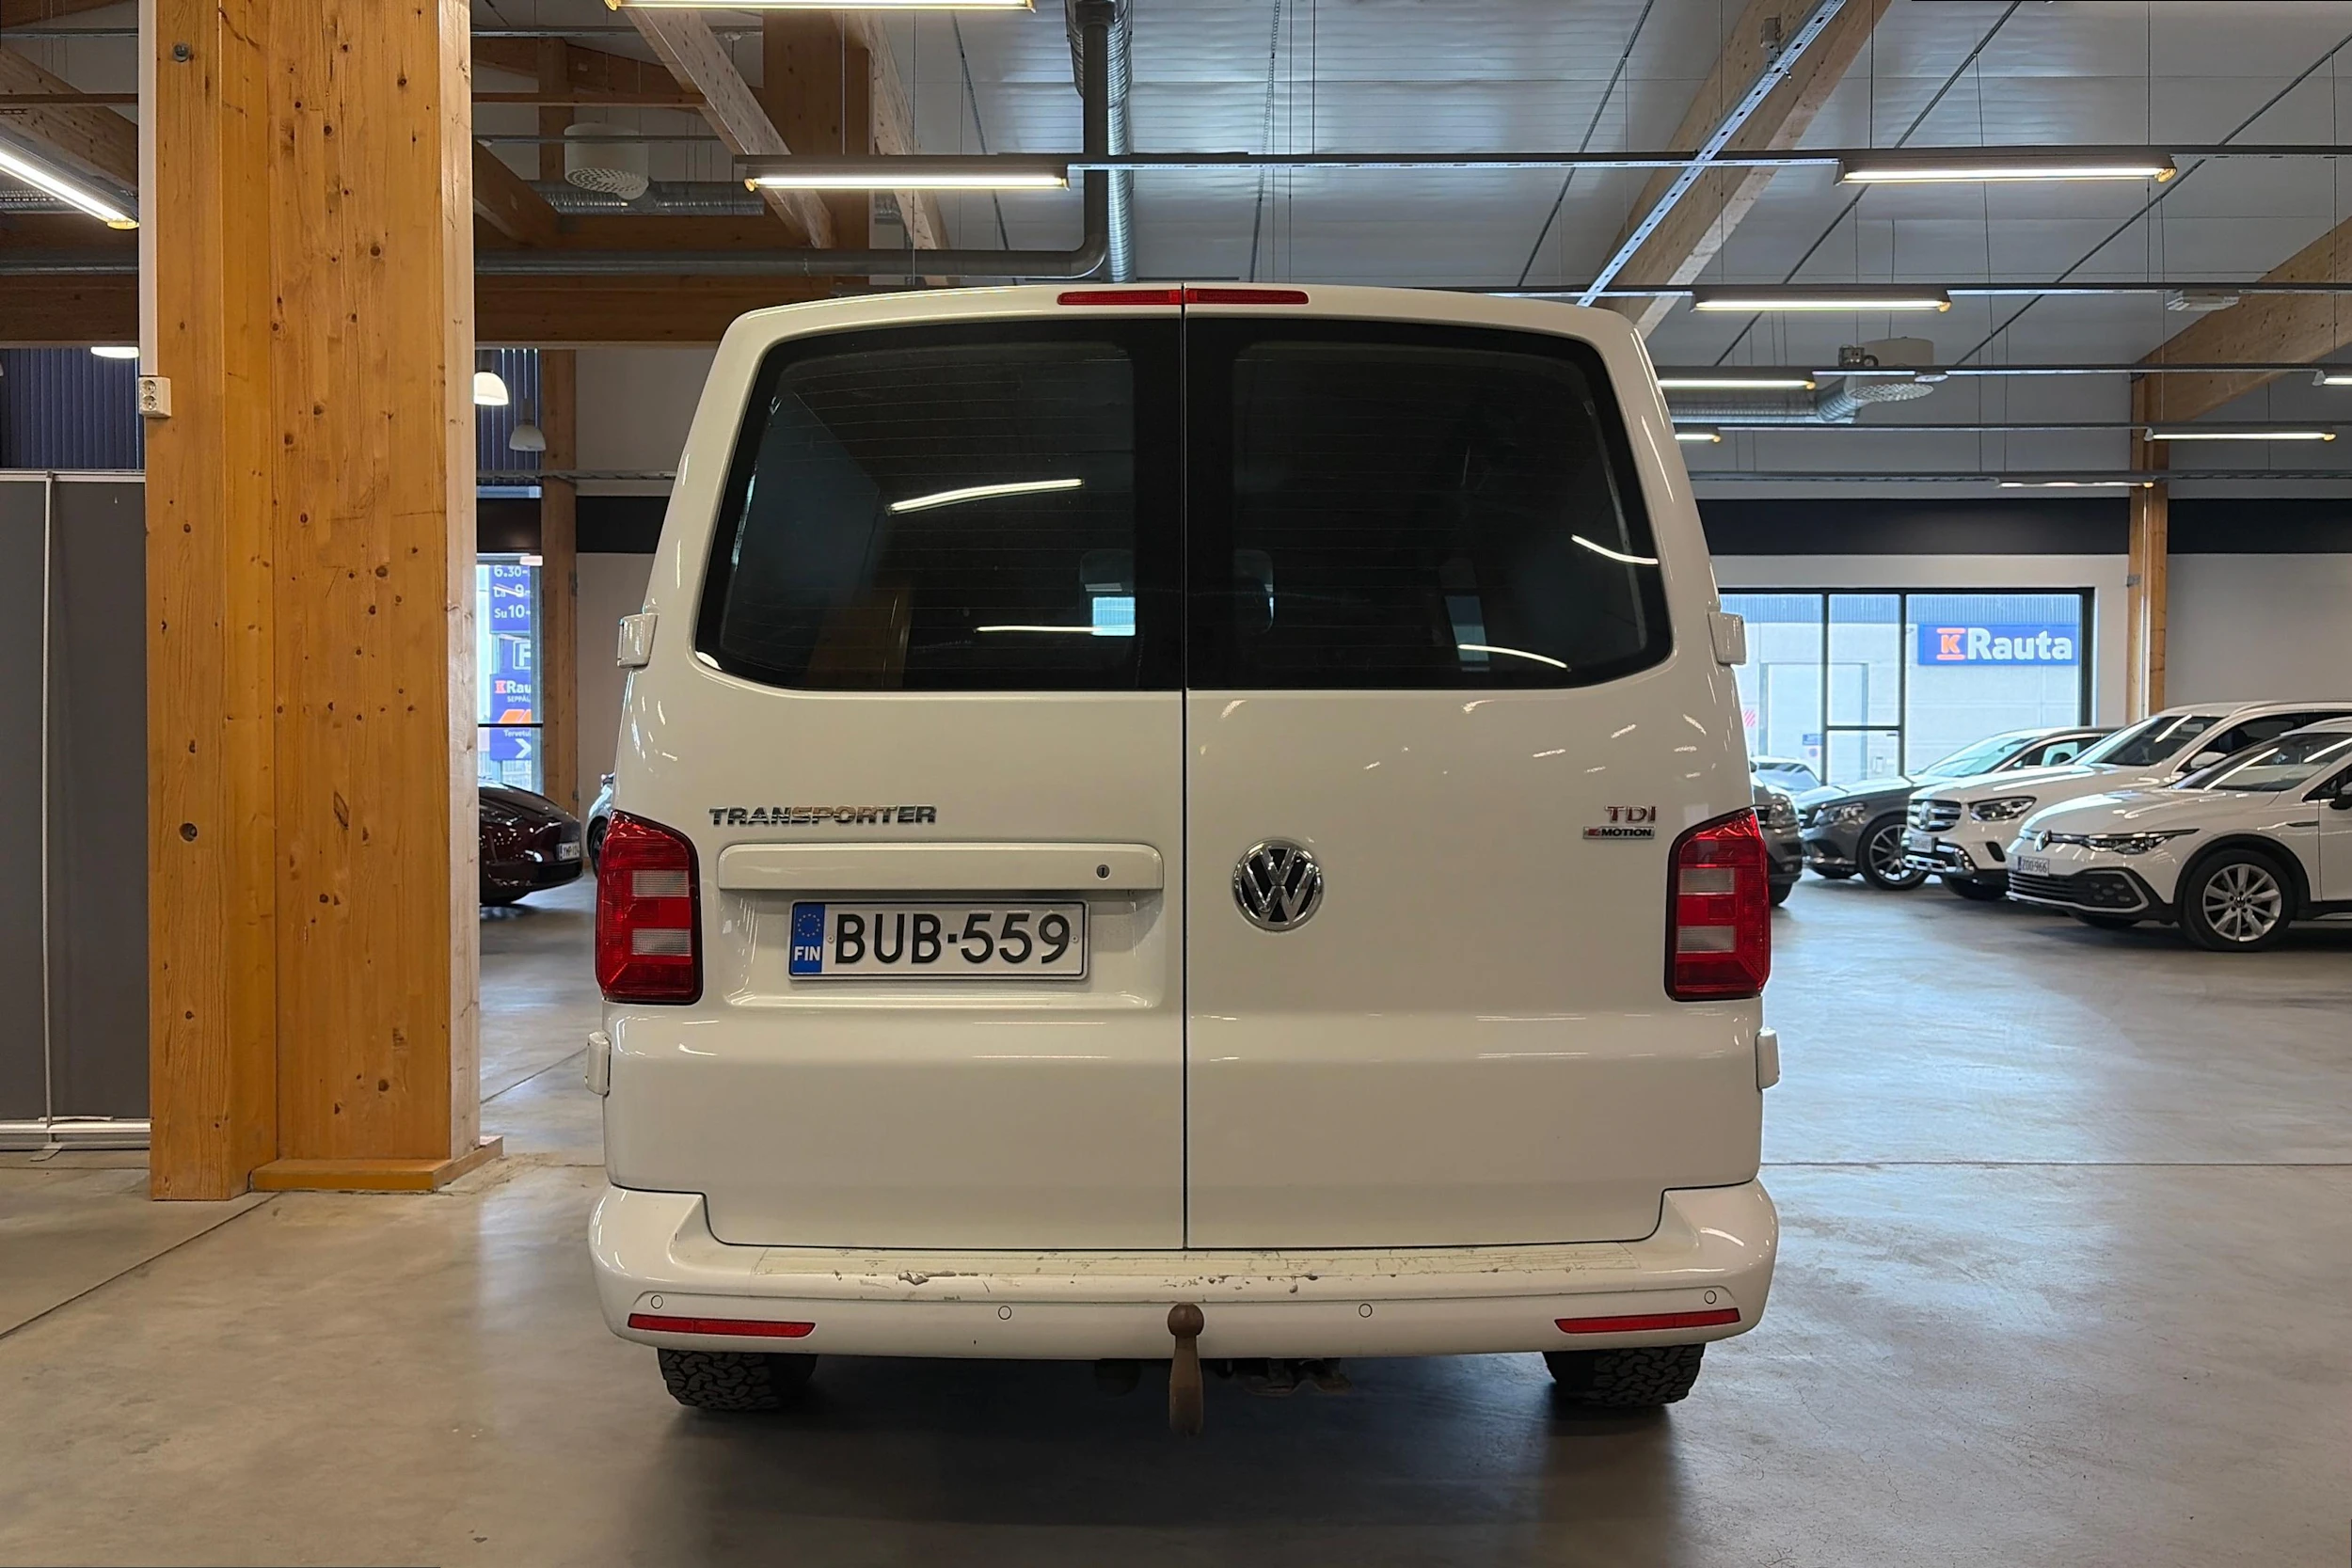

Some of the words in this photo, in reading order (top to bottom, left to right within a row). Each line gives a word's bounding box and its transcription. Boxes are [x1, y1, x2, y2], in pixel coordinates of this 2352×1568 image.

[494, 608, 507, 619] Su
[708, 804, 937, 826] TRANSPORTER
[1604, 805, 1657, 823] TDI
[834, 912, 1071, 964] BUB-559
[793, 945, 820, 961] FIN
